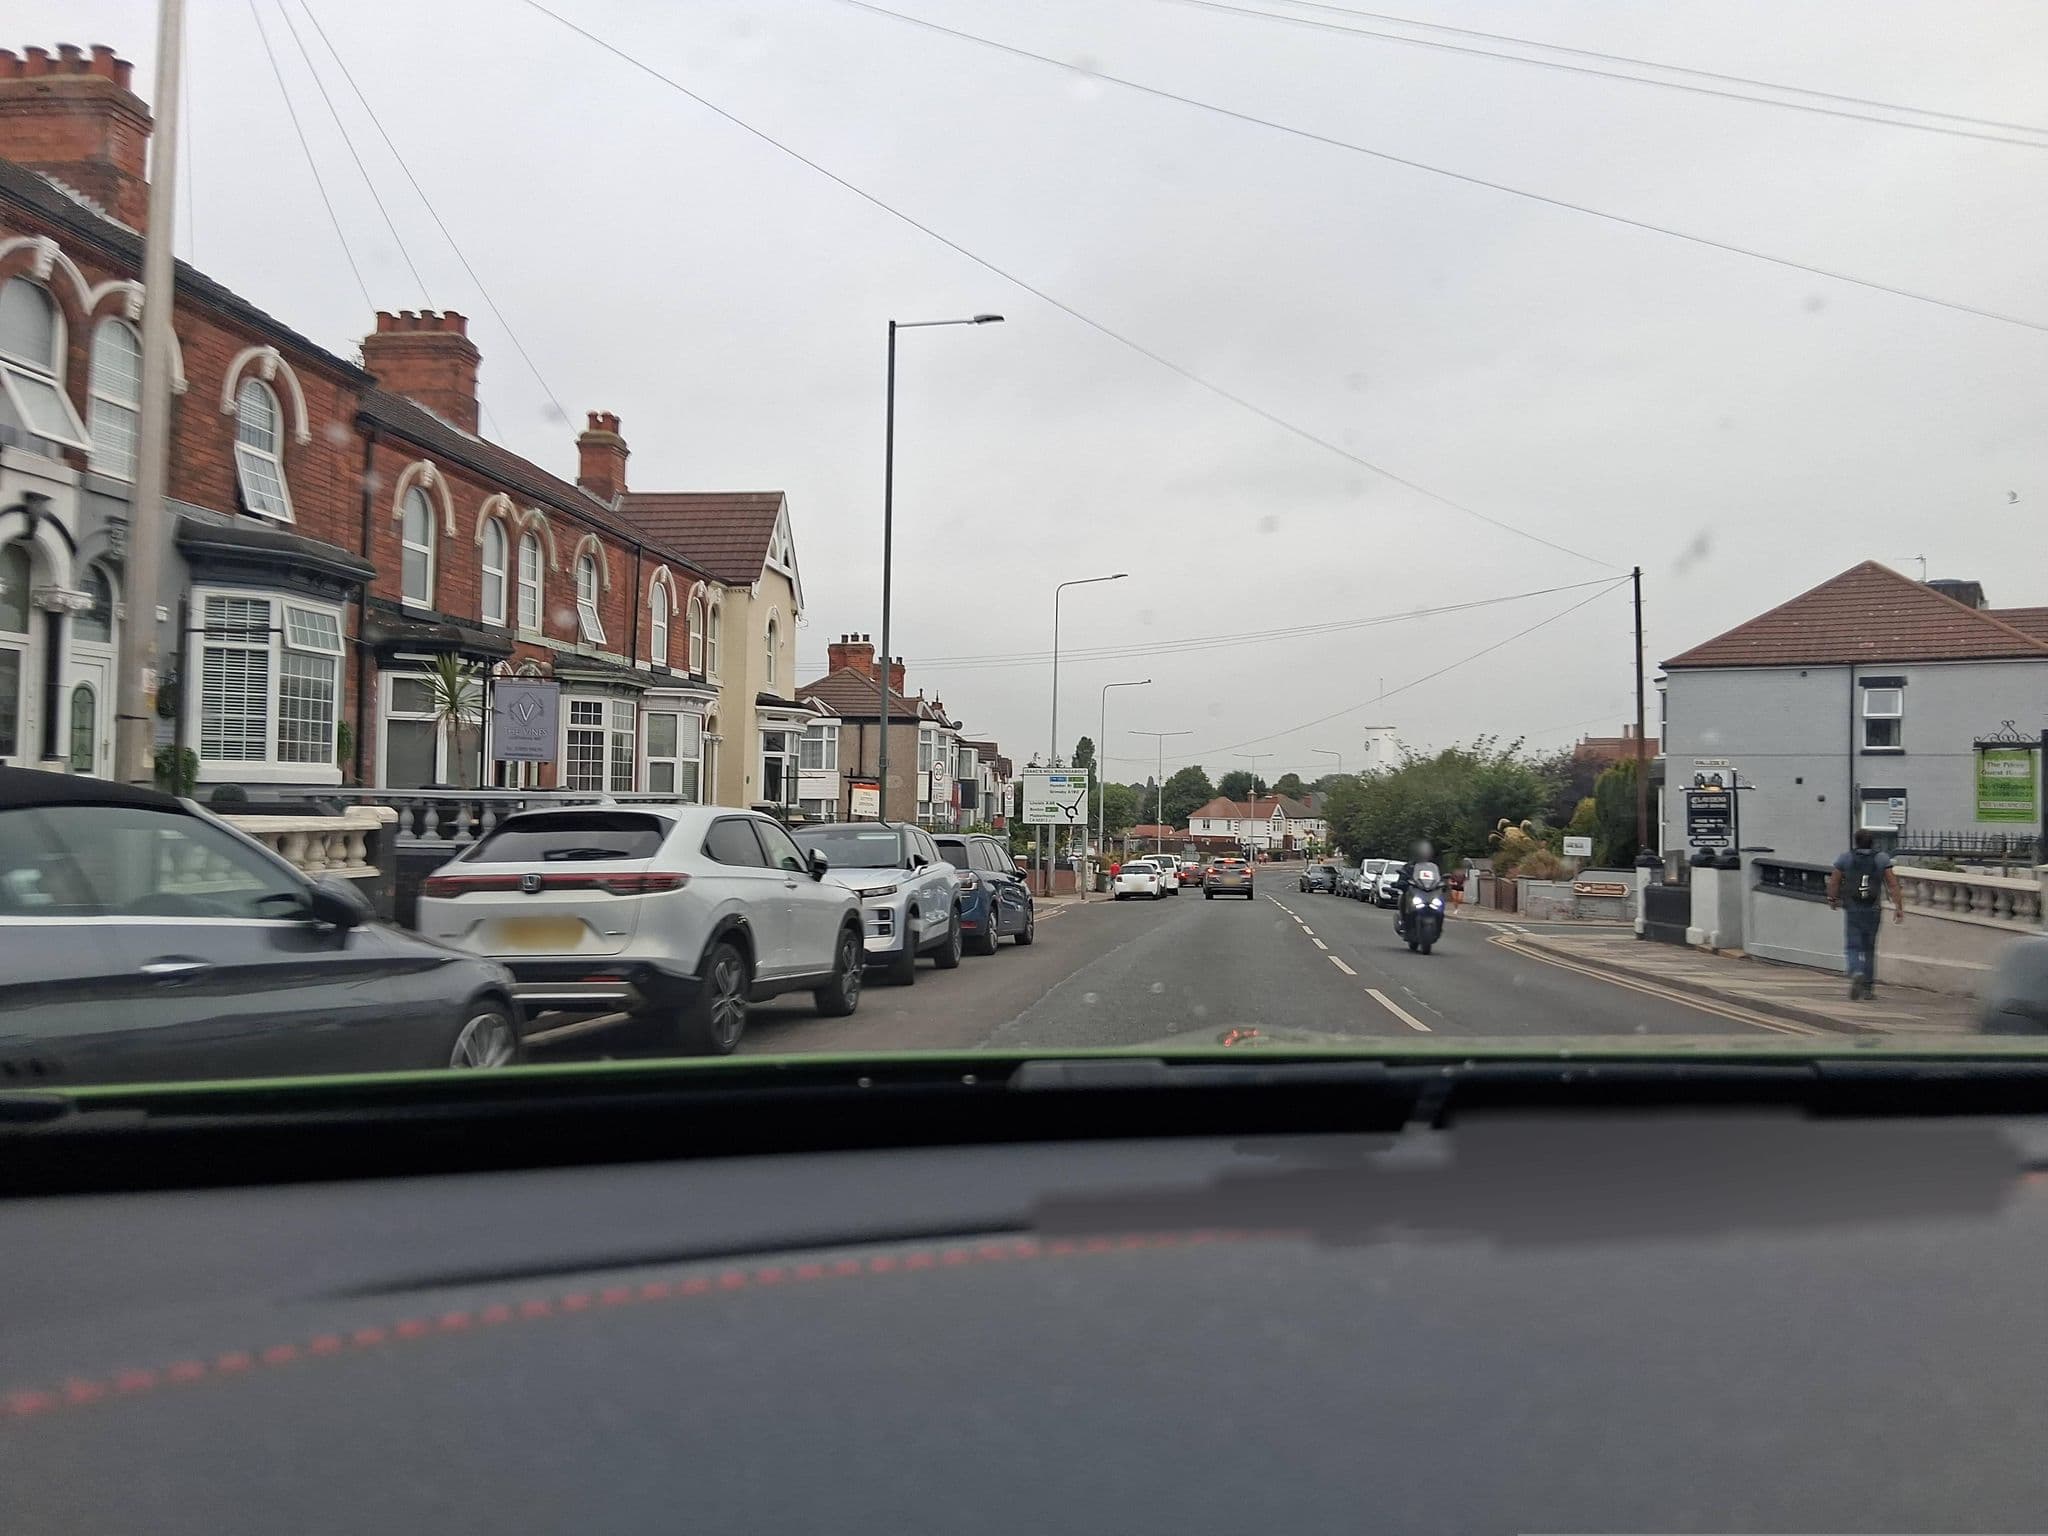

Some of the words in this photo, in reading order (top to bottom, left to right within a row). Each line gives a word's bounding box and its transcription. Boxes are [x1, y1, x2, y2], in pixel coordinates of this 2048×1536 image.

[519, 703, 535, 721] V
[504, 727, 520, 736] THE
[523, 727, 547, 736] VINES
